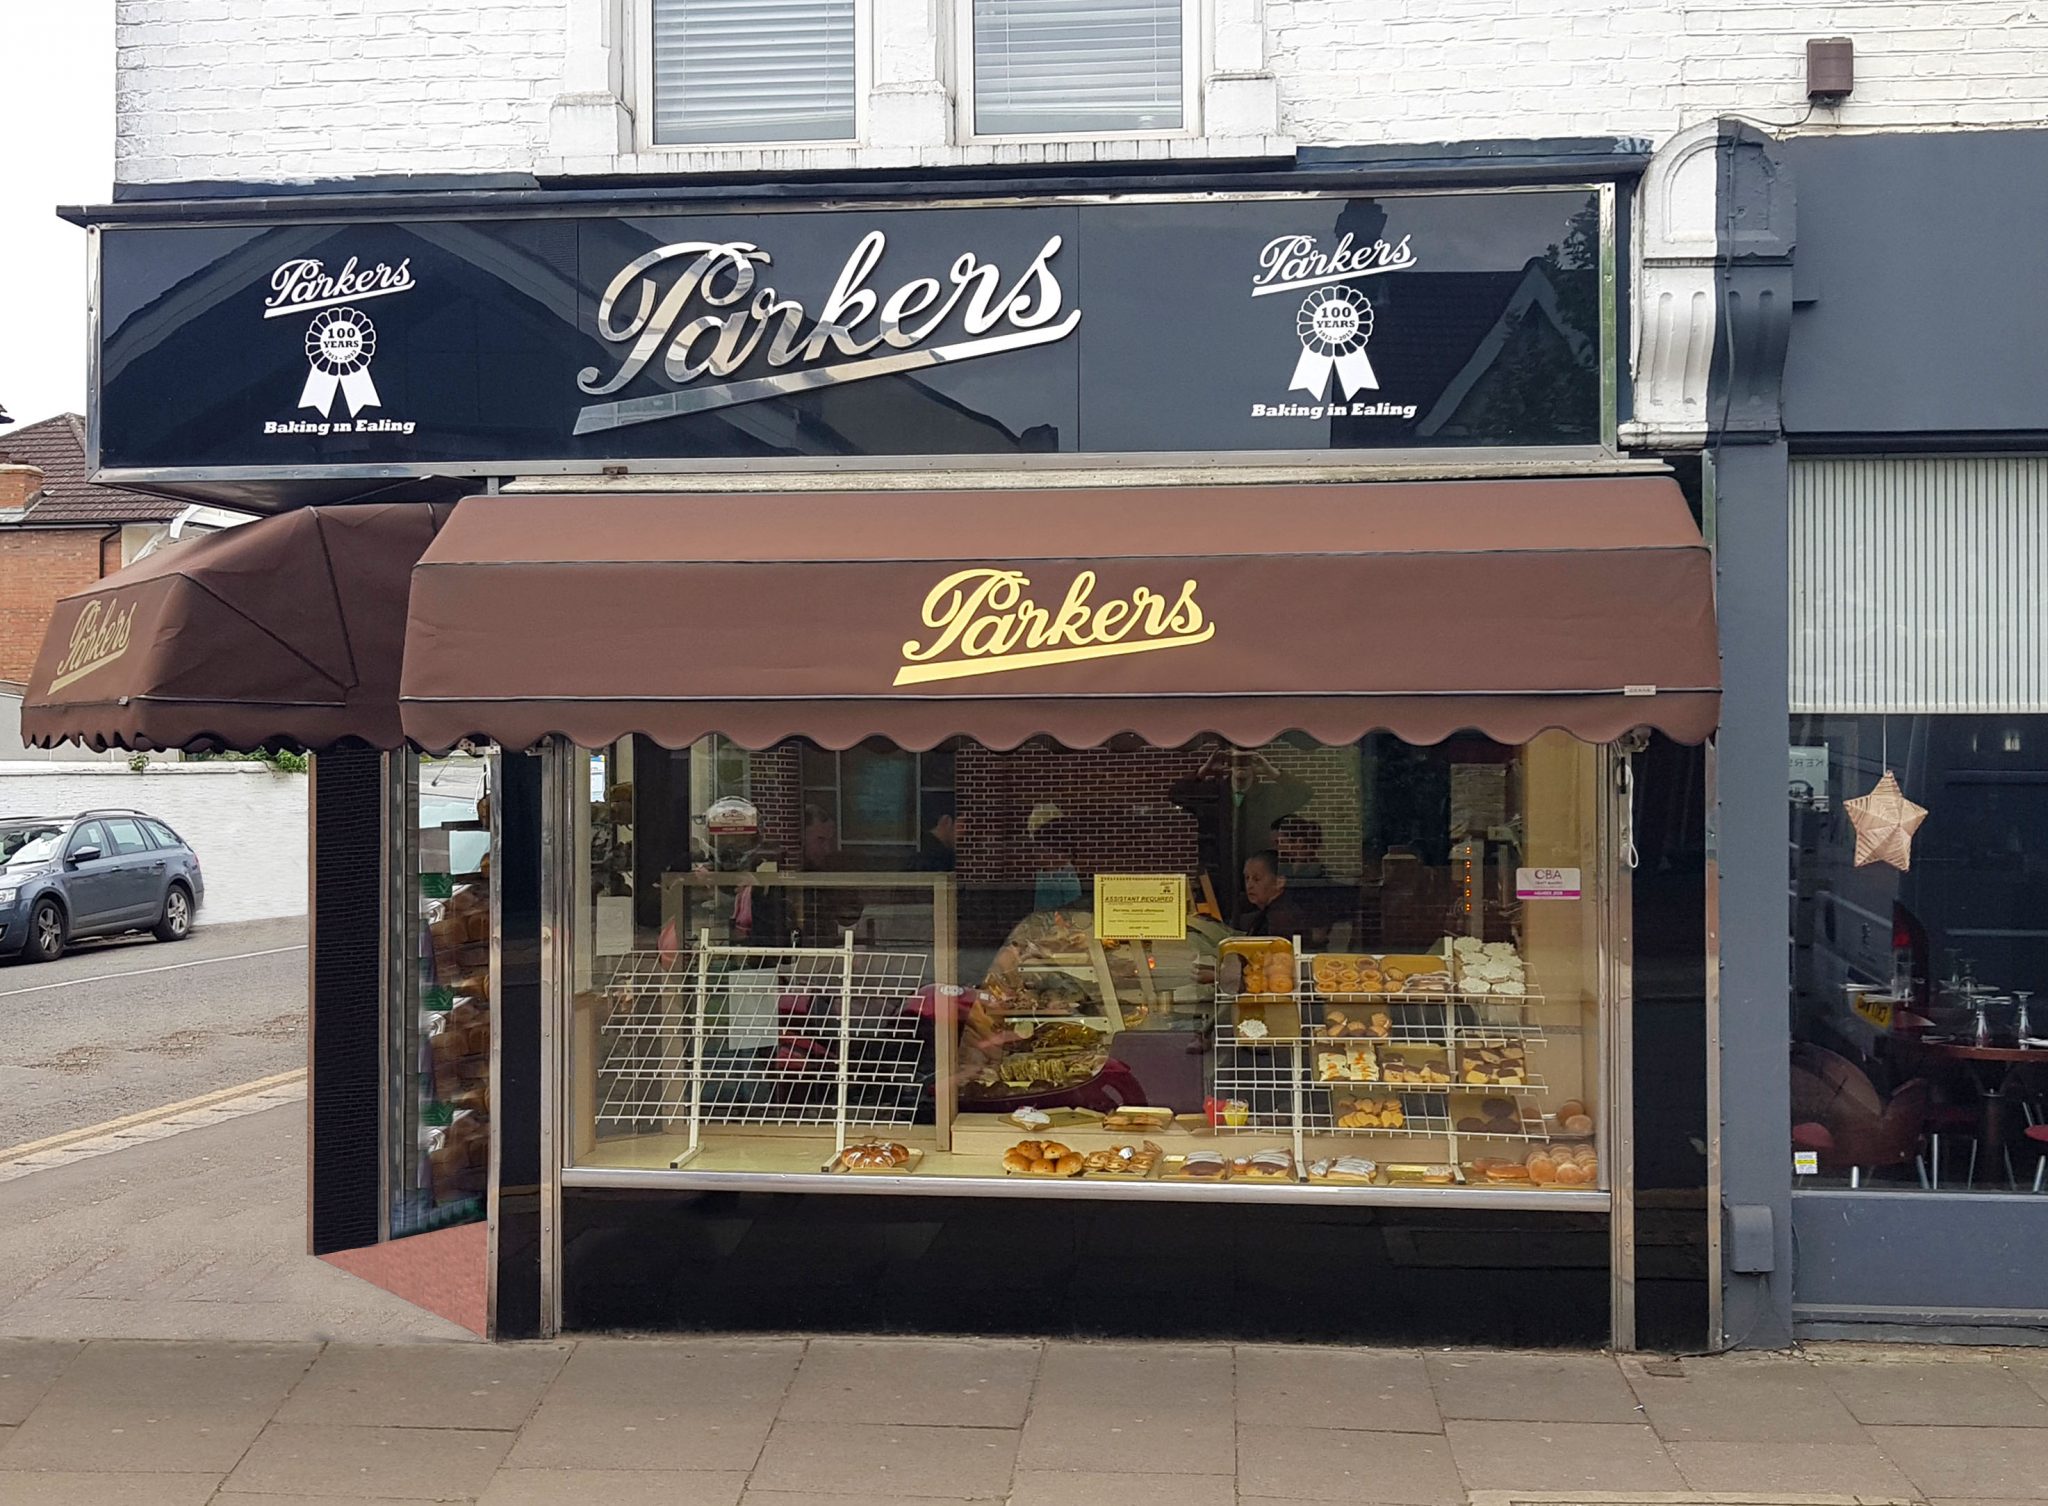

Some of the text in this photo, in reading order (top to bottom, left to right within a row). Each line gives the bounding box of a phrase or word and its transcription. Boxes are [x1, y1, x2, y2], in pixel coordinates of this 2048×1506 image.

[1253, 232, 1412, 285] Parkers
[265, 256, 411, 307] Parkers
[577, 230, 1063, 396] Parkers
[1321, 306, 1352, 318] 100
[327, 327, 356, 339] 100
[1316, 320, 1356, 328] YEARS
[323, 340, 359, 348] YEARS
[1251, 402, 1418, 420] Baking in Ealing
[264, 418, 416, 436] Baking in Ealing
[902, 568, 1204, 661] Parkers
[57, 598, 138, 676] Parkers
[1534, 869, 1562, 880] CBA
